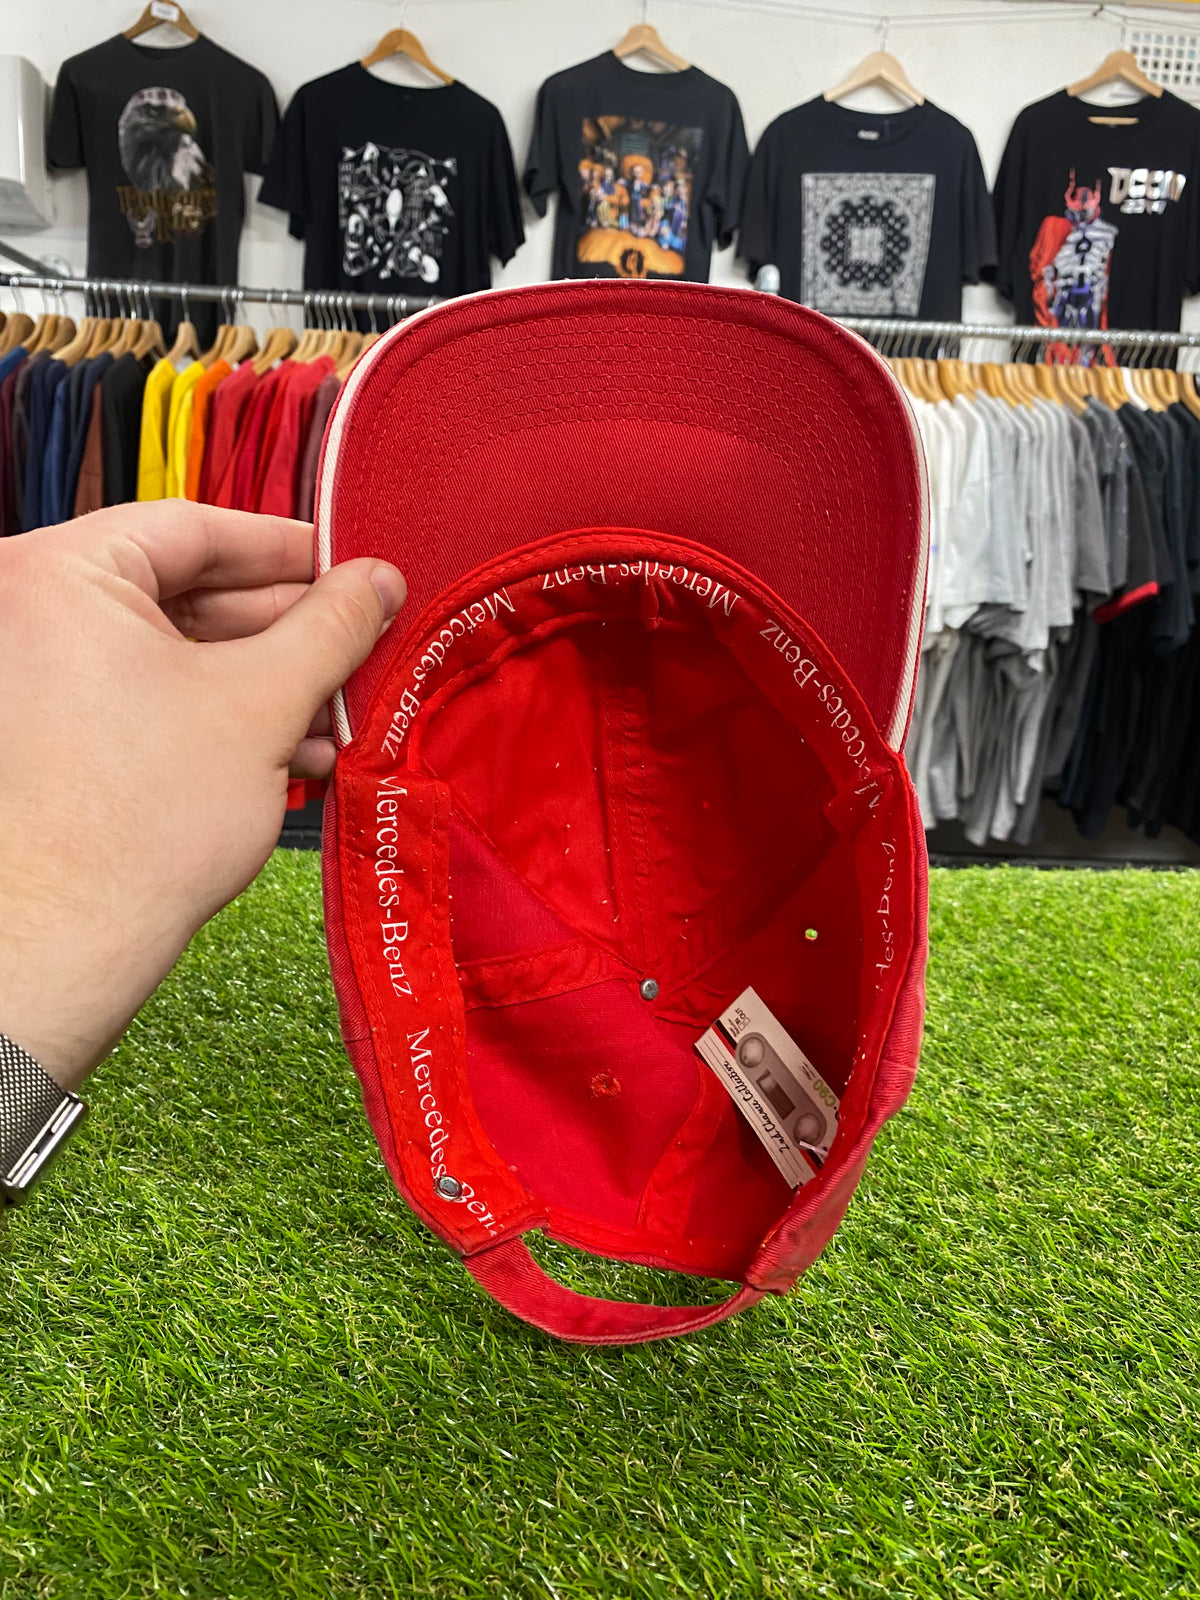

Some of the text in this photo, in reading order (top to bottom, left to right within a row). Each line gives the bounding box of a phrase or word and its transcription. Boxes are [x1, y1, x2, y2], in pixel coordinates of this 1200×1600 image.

[381, 587, 516, 760] Mercedes-Benz
[541, 560, 741, 617] Mercedes-Benz
[374, 776, 412, 997] Mercedes-Benz
